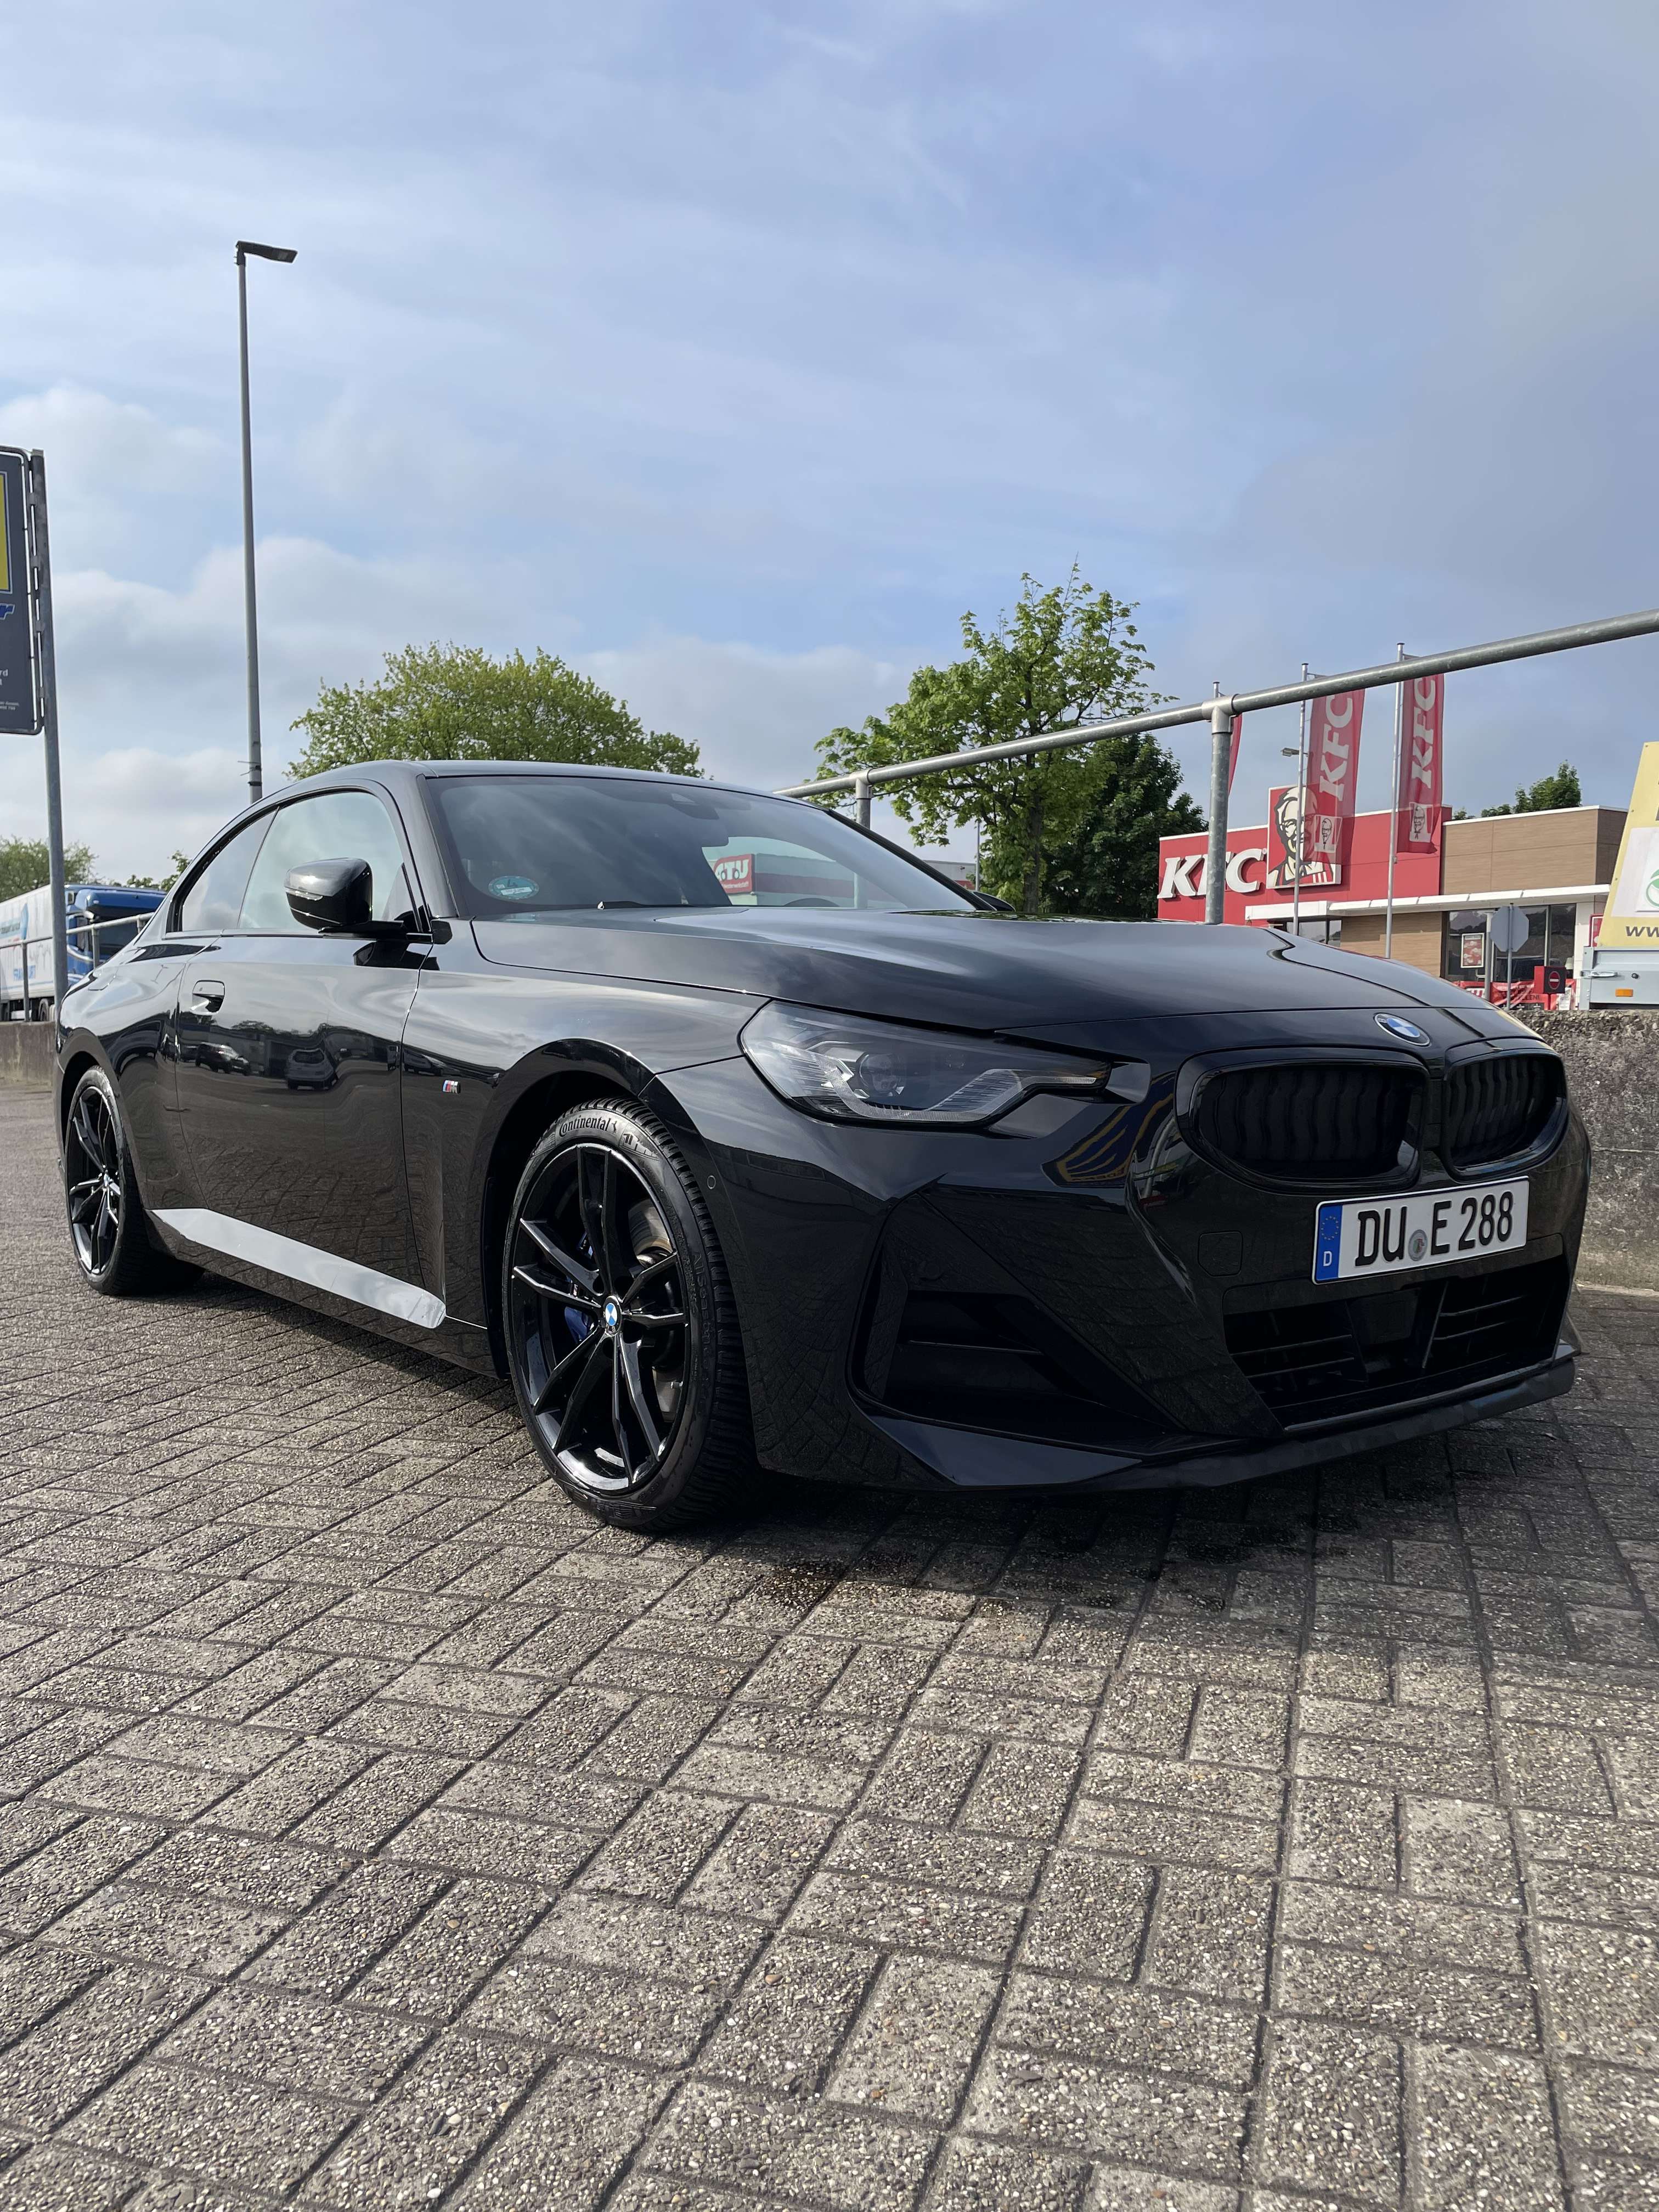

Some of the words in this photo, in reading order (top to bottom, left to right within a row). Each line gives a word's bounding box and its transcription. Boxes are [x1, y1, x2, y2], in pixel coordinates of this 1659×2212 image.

[1319, 694, 1353, 802] KFC
[1412, 677, 1436, 789] KFC
[559, 1115, 612, 1137] Continental
[1323, 1250, 1333, 1267] D
[1355, 1206, 1408, 1267] DU
[1431, 1200, 1452, 1256] E
[1458, 1191, 1514, 1251] 288
